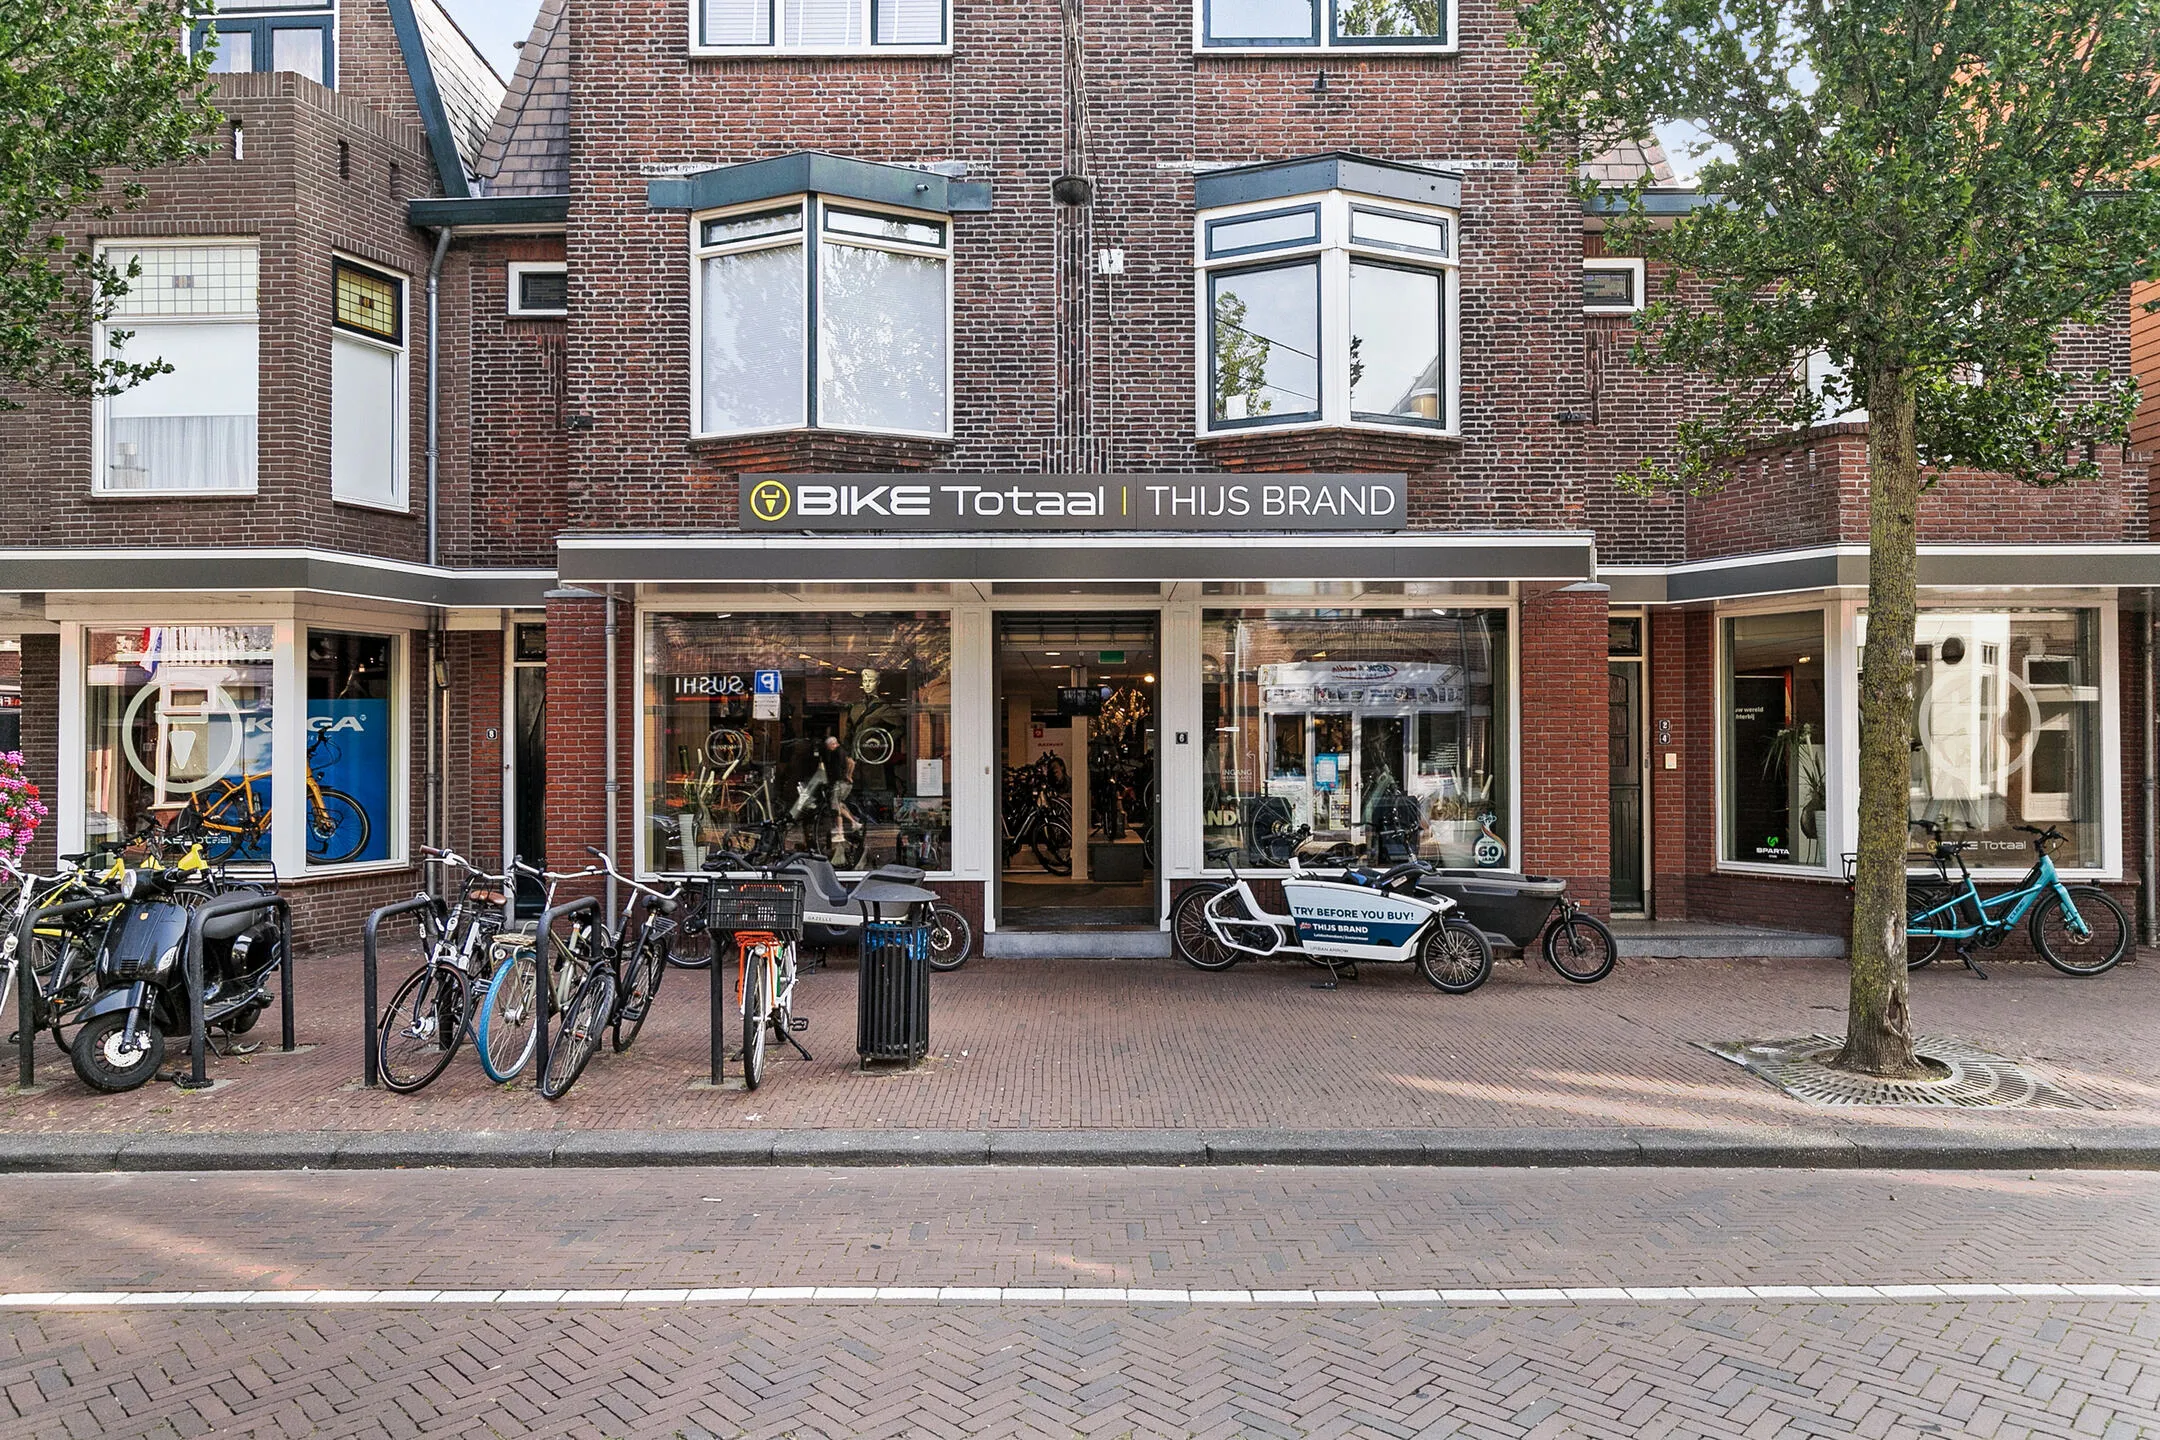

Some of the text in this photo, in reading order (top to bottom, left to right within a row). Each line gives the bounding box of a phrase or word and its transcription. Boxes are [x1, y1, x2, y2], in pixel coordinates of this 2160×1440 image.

[797, 485, 1397, 516] BIKE Totaal THIJS BRAND
[244, 716, 364, 732] KGA
[1980, 840, 2027, 850] Totaal
[1478, 846, 1499, 857] 60
[1756, 847, 1790, 855] SPARTA
[1294, 906, 1414, 921] TRY BEFORE YOU BUY!
[1312, 923, 1337, 932] THIJS
[1337, 925, 1369, 934] BRAND
